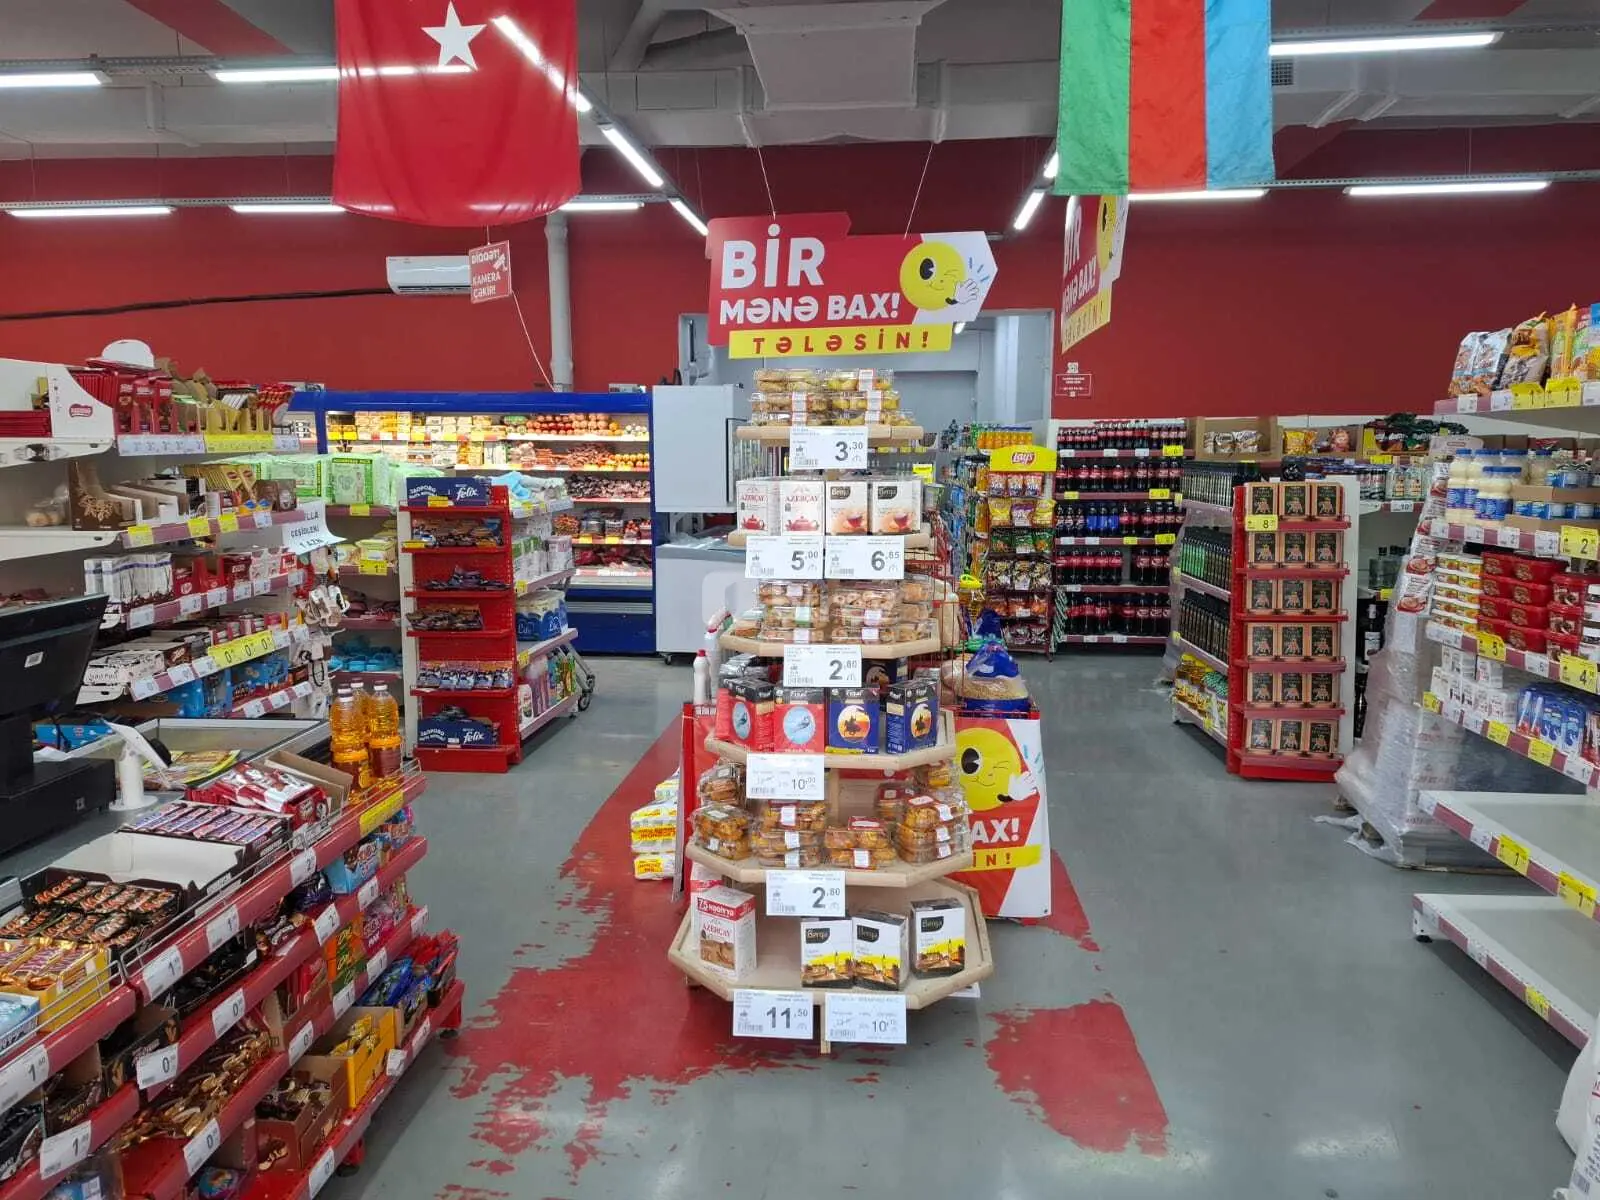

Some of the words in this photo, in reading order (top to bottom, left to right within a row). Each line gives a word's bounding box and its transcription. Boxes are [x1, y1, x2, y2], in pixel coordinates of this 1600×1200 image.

[721, 223, 826, 290] BİR
[719, 295, 819, 325] MƏNƏ
[826, 292, 901, 321] BAX!
[970, 816, 1020, 844] AX!
